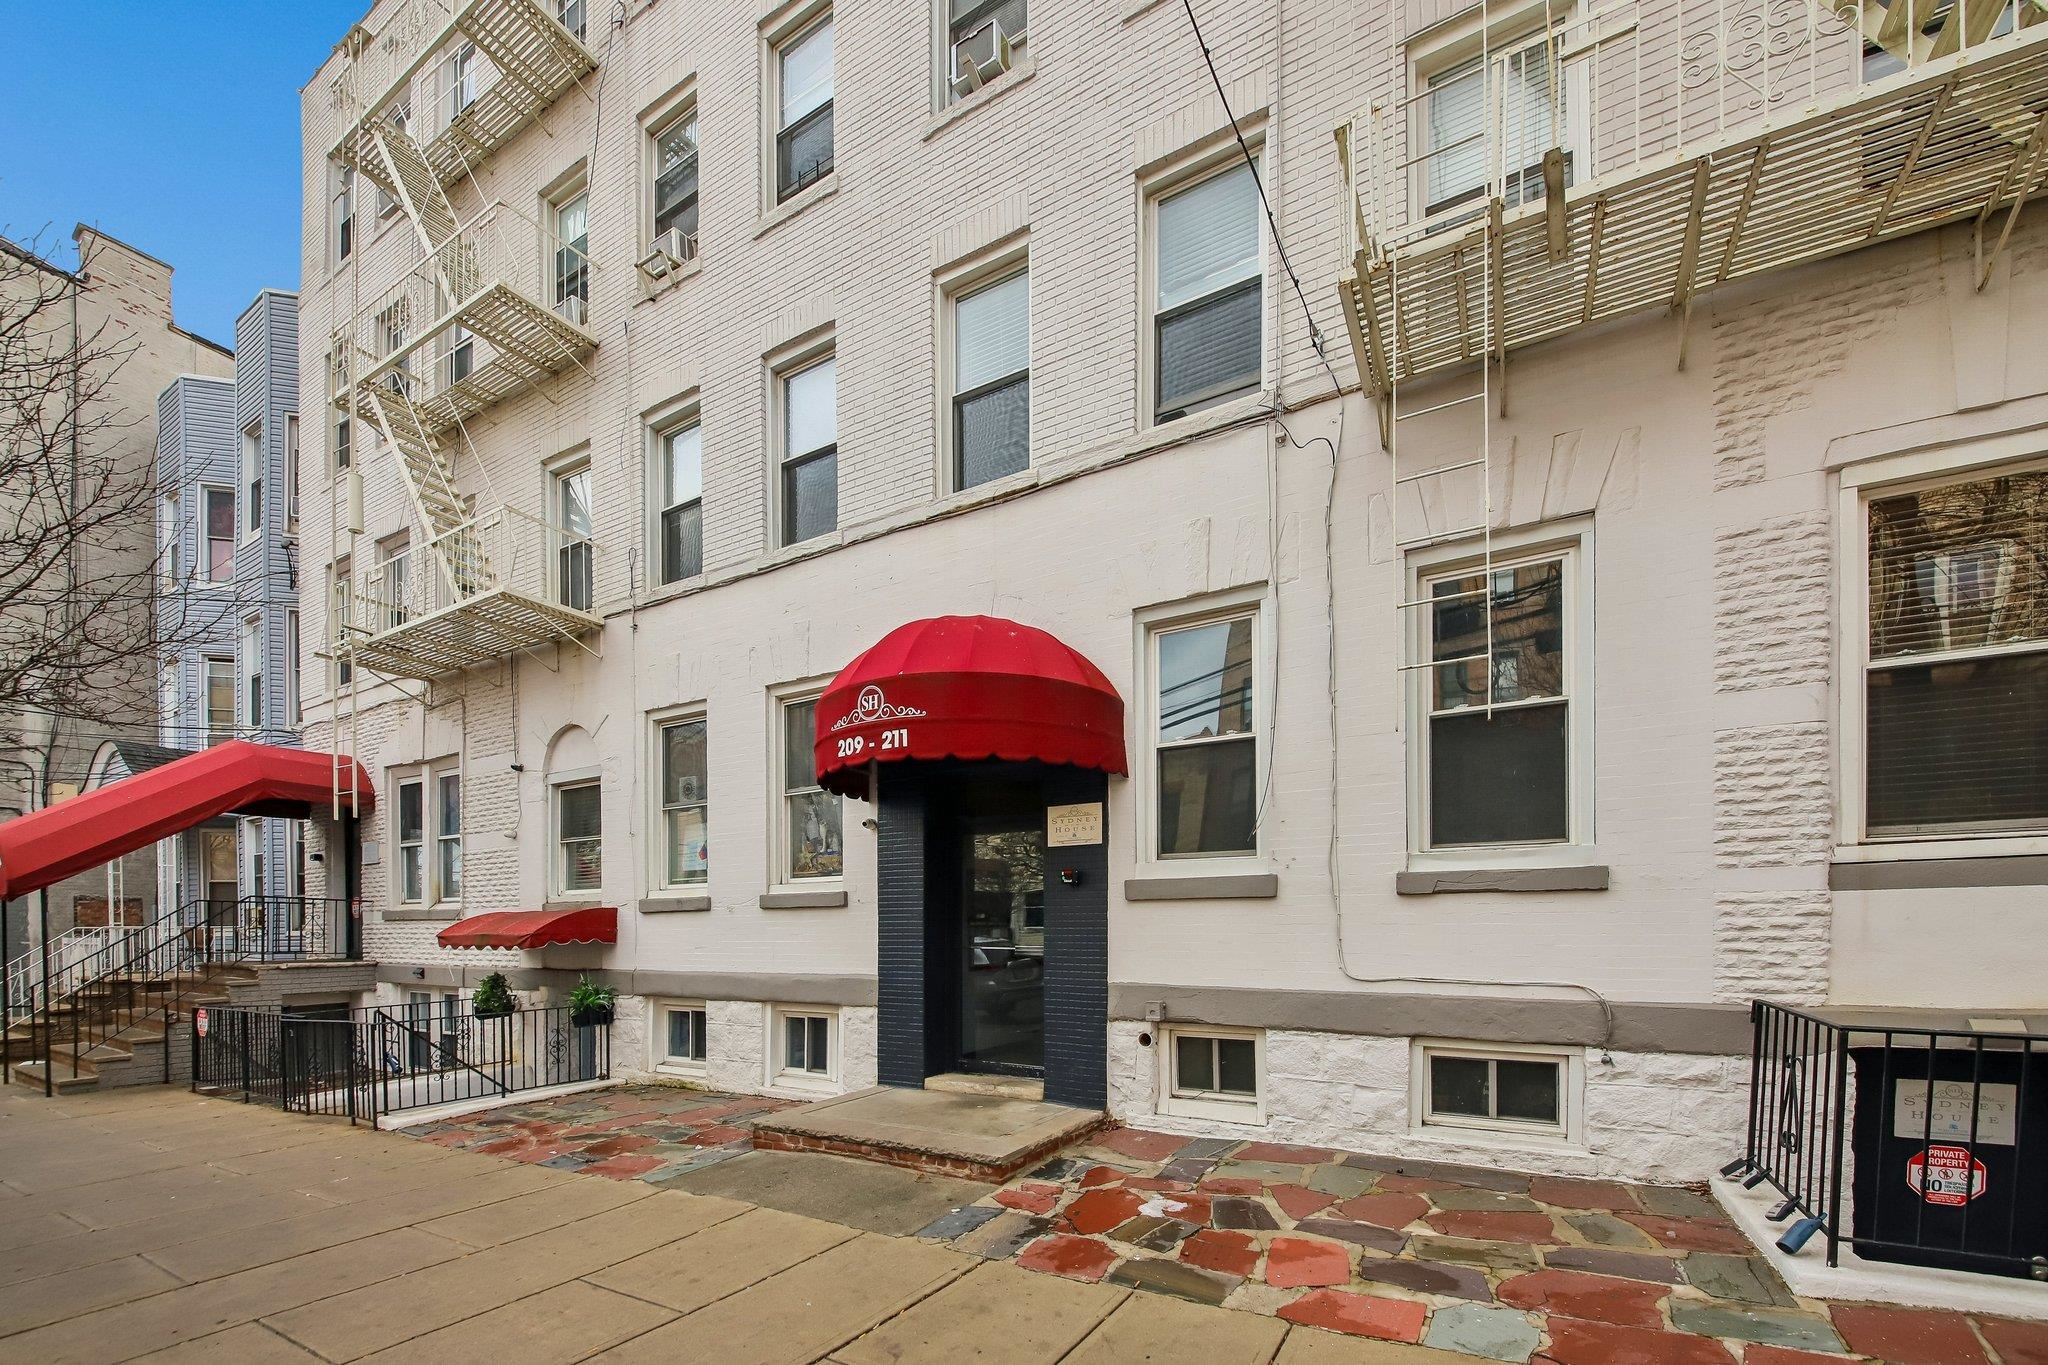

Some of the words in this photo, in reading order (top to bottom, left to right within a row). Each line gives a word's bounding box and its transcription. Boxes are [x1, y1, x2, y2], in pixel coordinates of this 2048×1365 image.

[861, 694, 879, 711] SH
[838, 736, 864, 757] 209
[881, 728, 908, 750] 211
[1051, 816, 1098, 824] SYDNEY
[1055, 825, 1096, 833] HOUSE
[1904, 1097, 2007, 1111] SDNEY
[1911, 1110, 2000, 1124] HOUE
[1928, 1149, 1966, 1160] PRIVATE
[1928, 1157, 1969, 1168] ROPERTY
